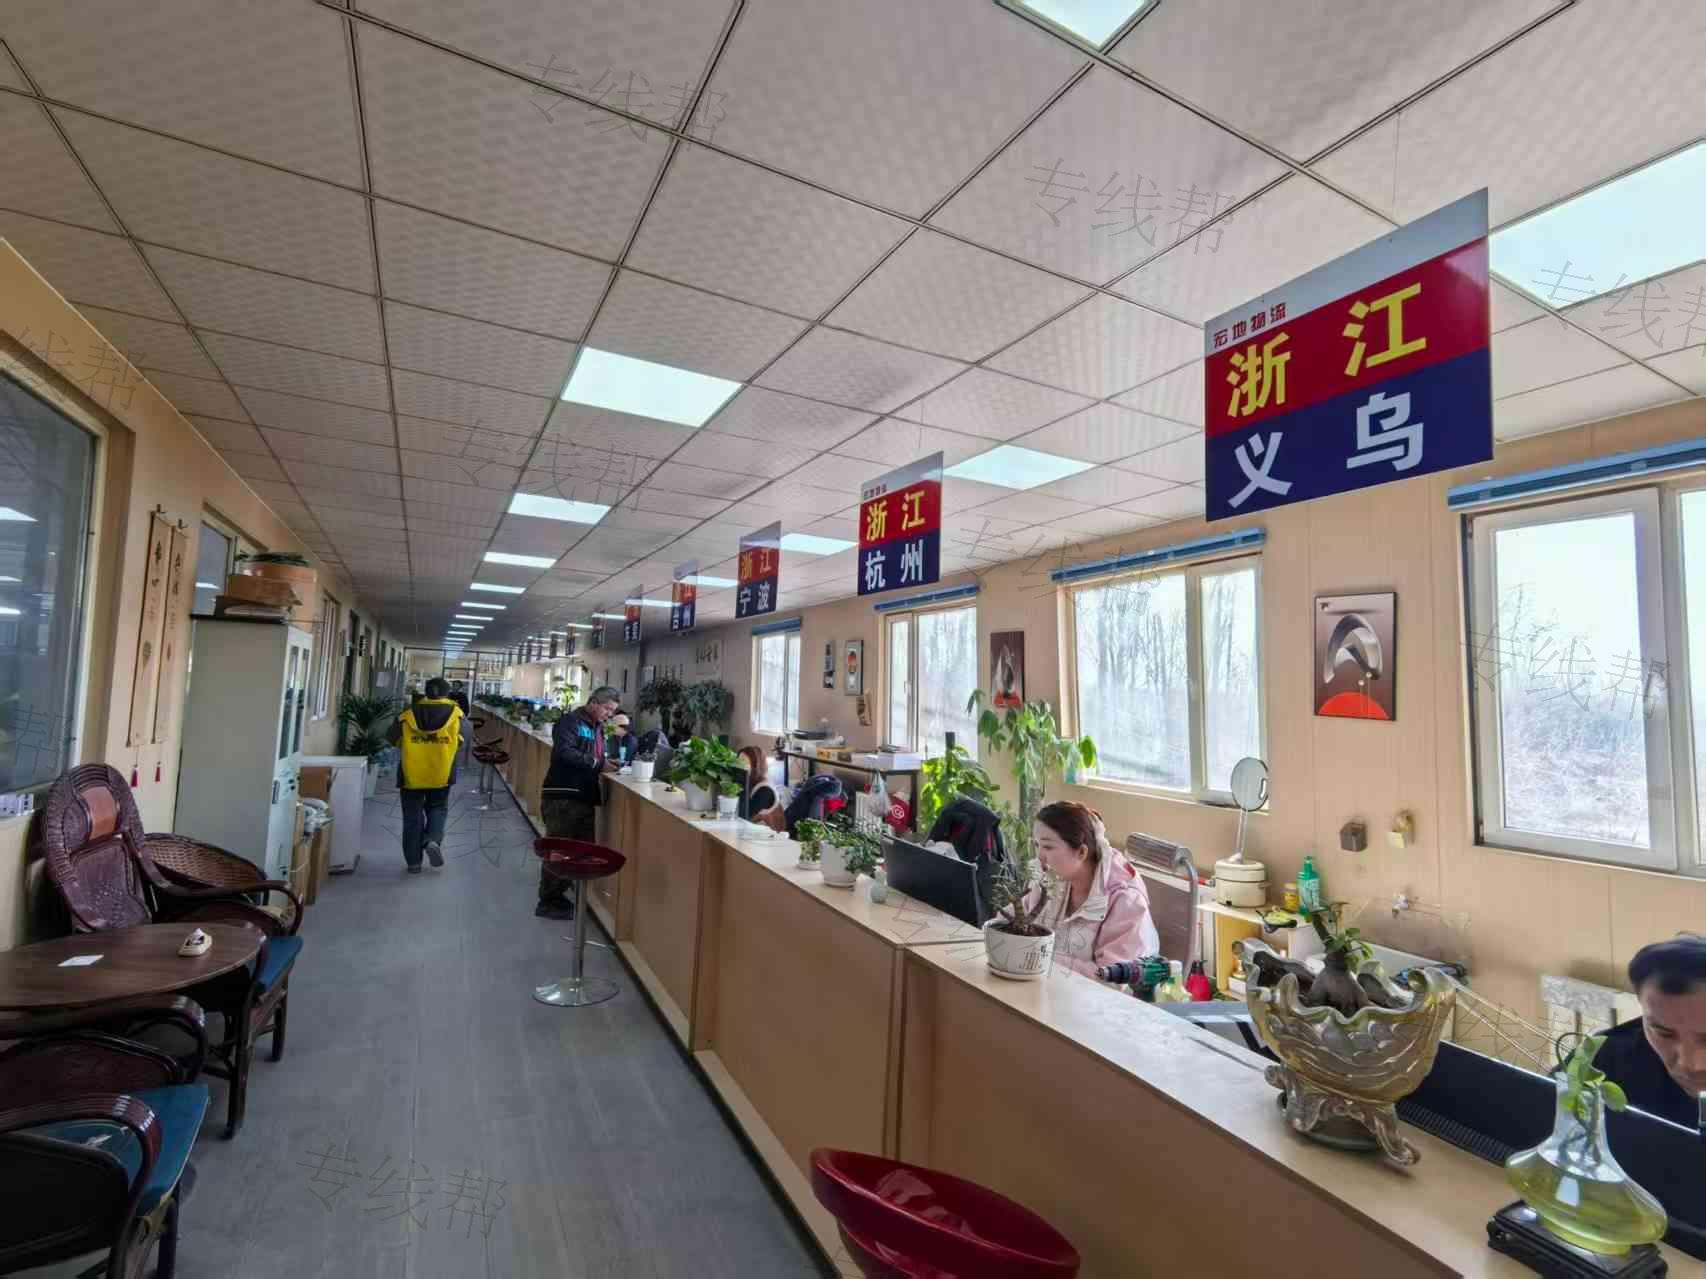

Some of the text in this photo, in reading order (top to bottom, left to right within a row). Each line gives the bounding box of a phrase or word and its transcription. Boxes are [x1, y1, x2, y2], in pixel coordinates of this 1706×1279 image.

[1227, 282, 1427, 417] 浙江
[1228, 392, 1424, 508] 义乌
[867, 490, 925, 541] 浙江
[866, 539, 923, 590] 杭州
[739, 582, 770, 615] 宁波
